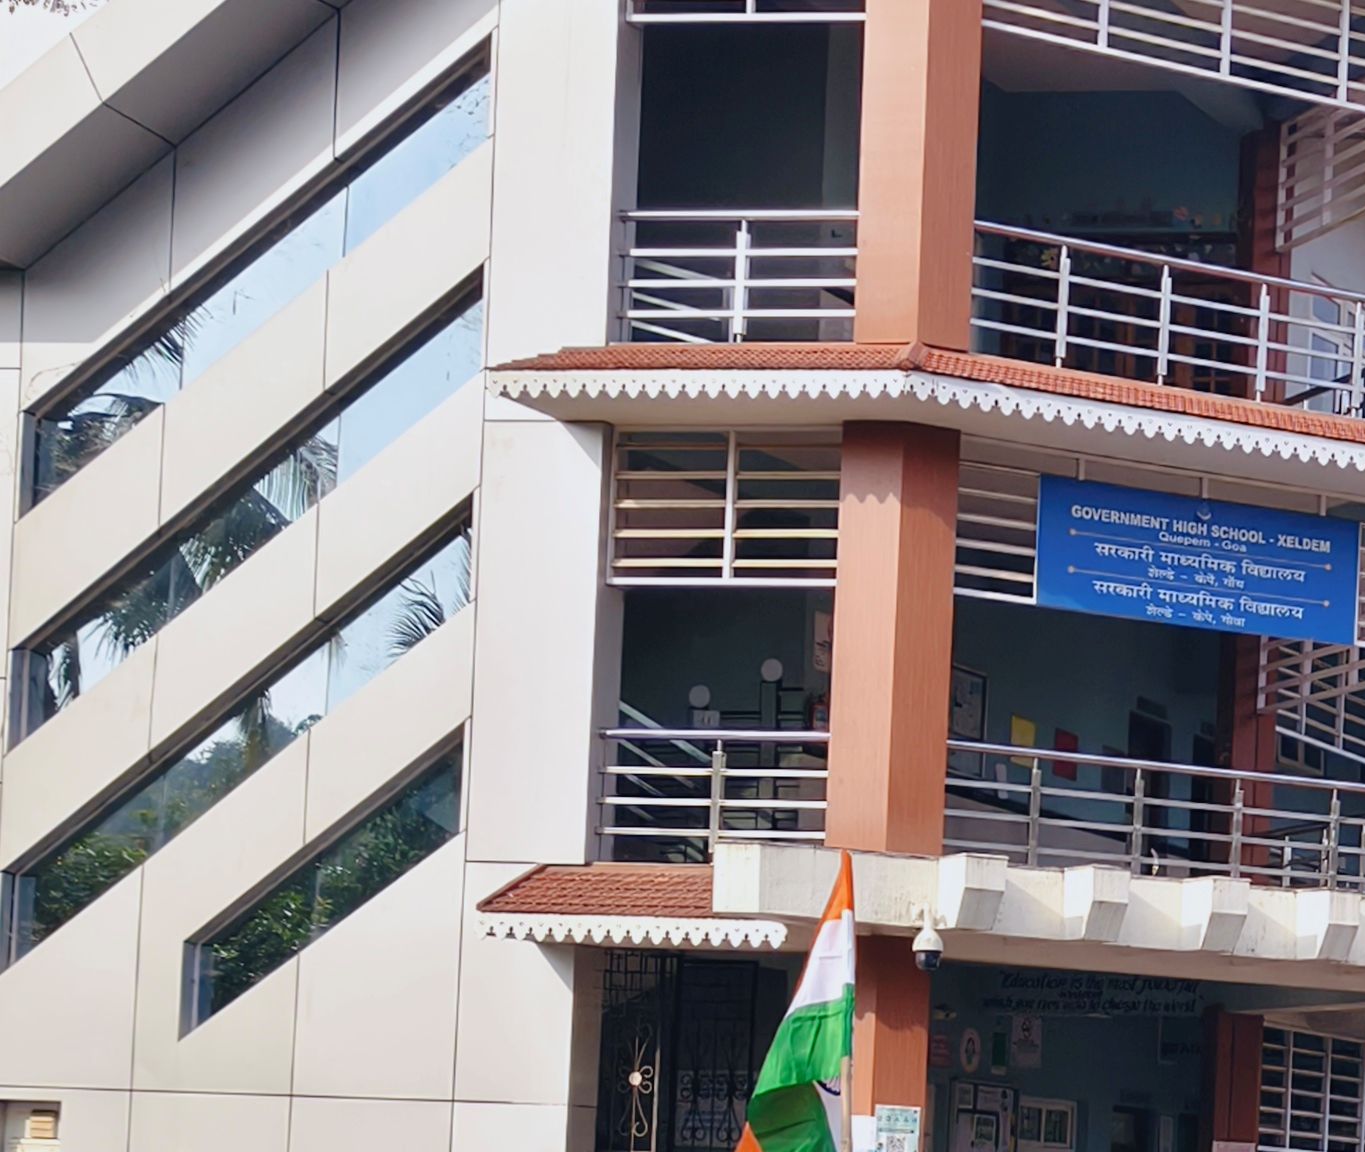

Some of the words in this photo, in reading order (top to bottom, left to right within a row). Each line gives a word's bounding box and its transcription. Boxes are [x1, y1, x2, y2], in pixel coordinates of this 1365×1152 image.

[1071, 504, 1169, 531] GOVERNMENT
[1172, 520, 1207, 536] HIGH
[1211, 525, 1266, 545] SCHOOL
[1277, 533, 1331, 553] XELDEM
[1221, 540, 1247, 553] Goa
[1094, 541, 1155, 563] सरकारी
[1159, 549, 1237, 575] माध्यमिक
[1241, 559, 1306, 583] विद्यालय
[1092, 580, 1153, 601] सरकारी
[1158, 588, 1235, 612] माध्यमिक
[1239, 596, 1304, 620] विद्यालय
